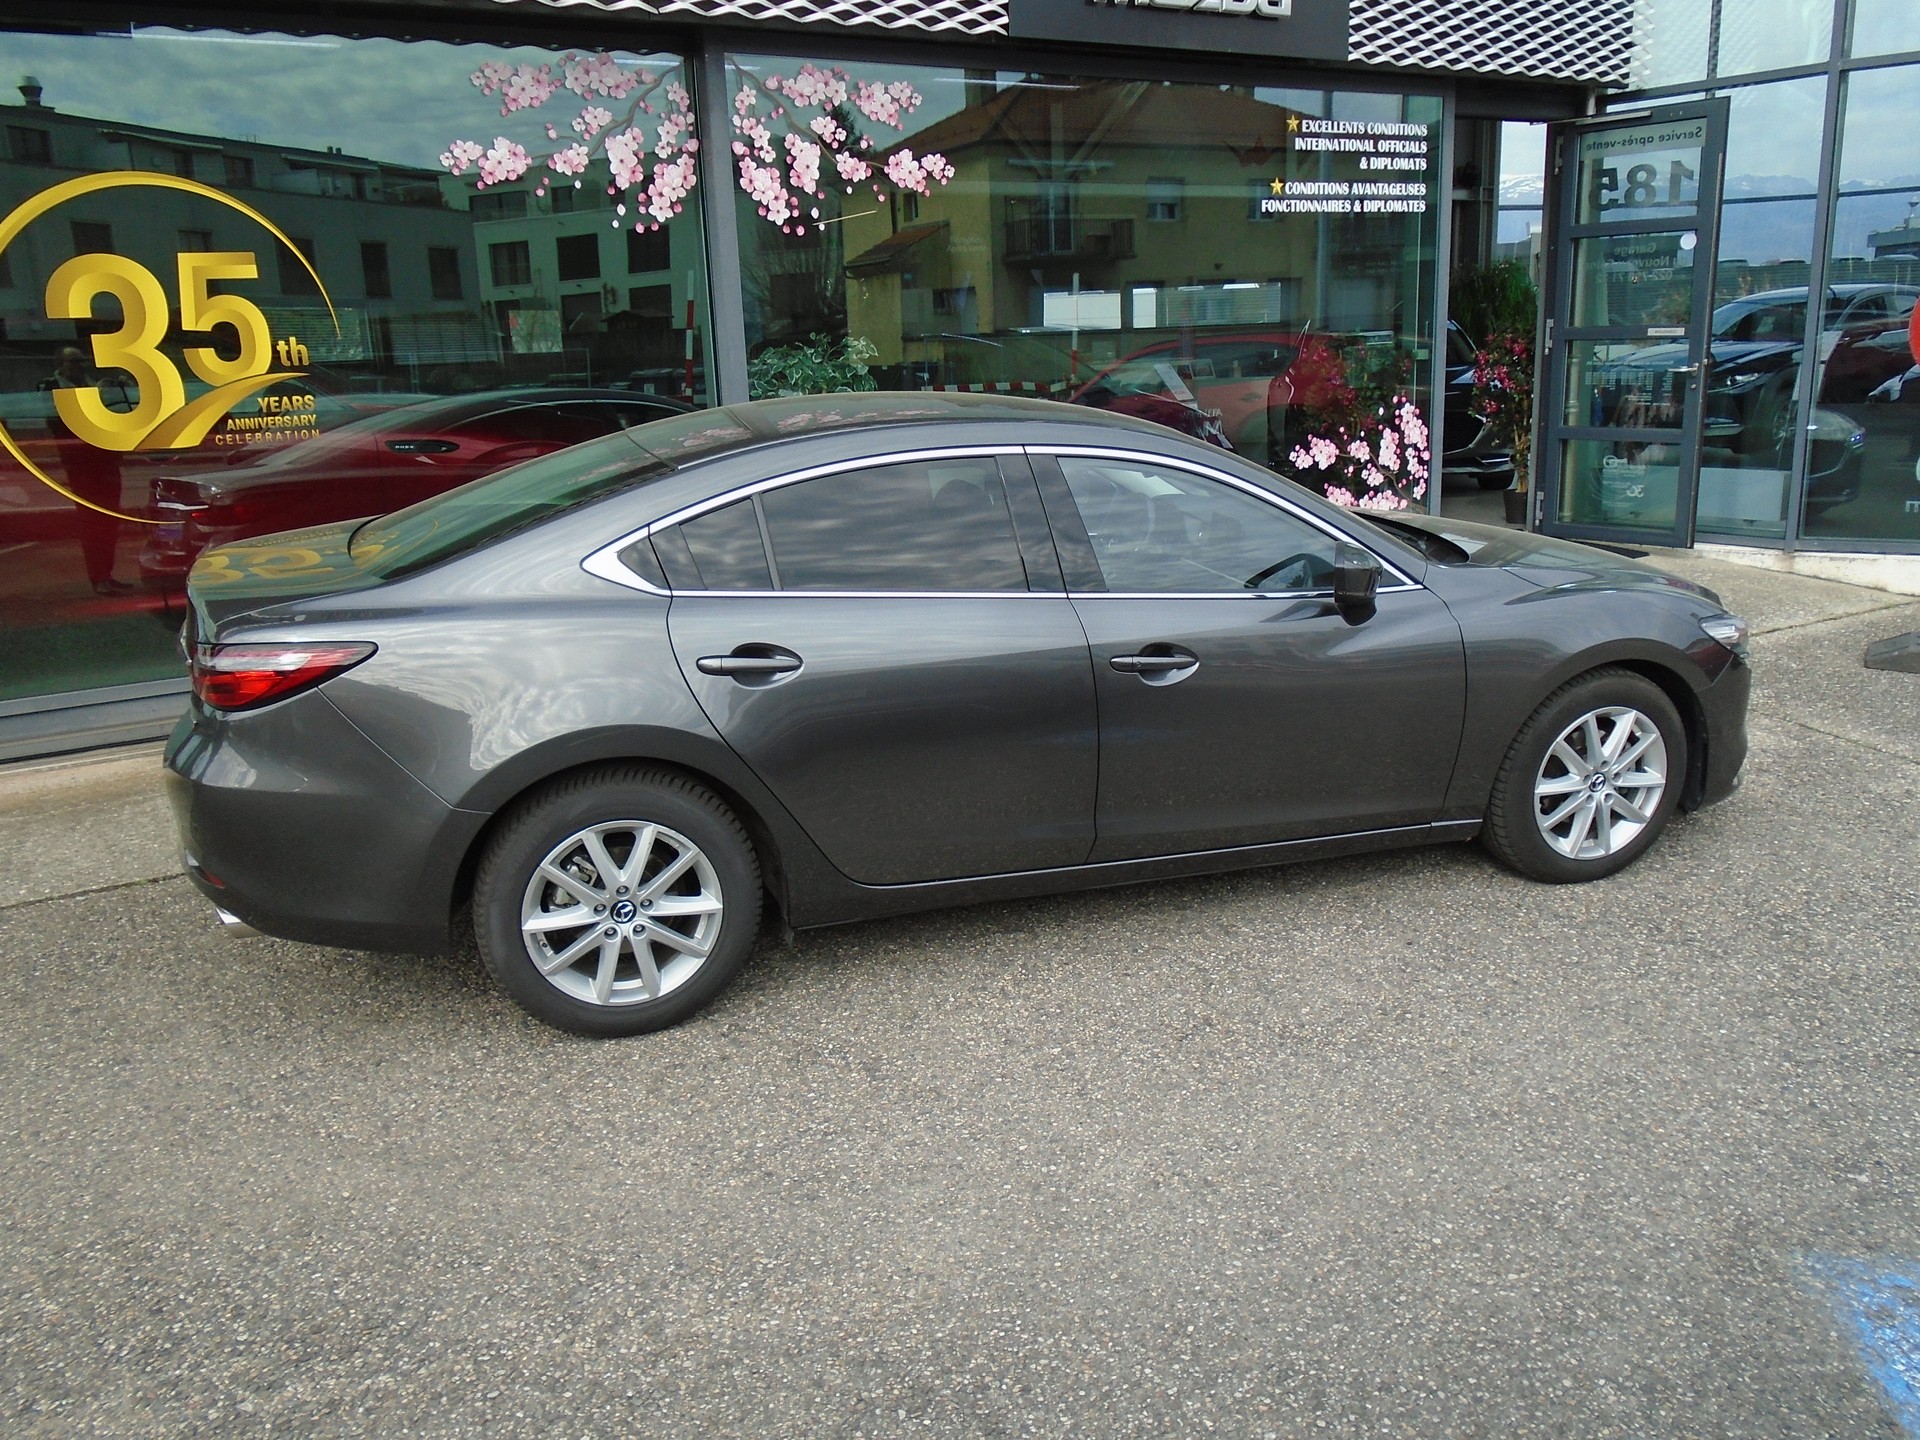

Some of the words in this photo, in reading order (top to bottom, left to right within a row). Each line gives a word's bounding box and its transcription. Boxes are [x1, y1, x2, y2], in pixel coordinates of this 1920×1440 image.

[1302, 120, 1365, 134] EXCELLENTS
[1368, 122, 1428, 136] CONDITIONS
[1295, 138, 1376, 152] INTERNATIONAL
[1378, 140, 1428, 153] OFFICIALS
[1360, 157, 1368, 169] &
[1370, 157, 1427, 170] DIPLOMATS
[1285, 182, 1349, 195] CONDITIONS
[1352, 183, 1426, 196] AVANTAGEUSES
[1262, 200, 1350, 212] FONCTIONNAIRES
[1353, 200, 1362, 212] &
[1364, 200, 1426, 212] DIPLOMATES
[257, 394, 316, 413] YEARS
[227, 414, 316, 431] ANNIVERSARY
[215, 429, 320, 445] CELEBRATION
